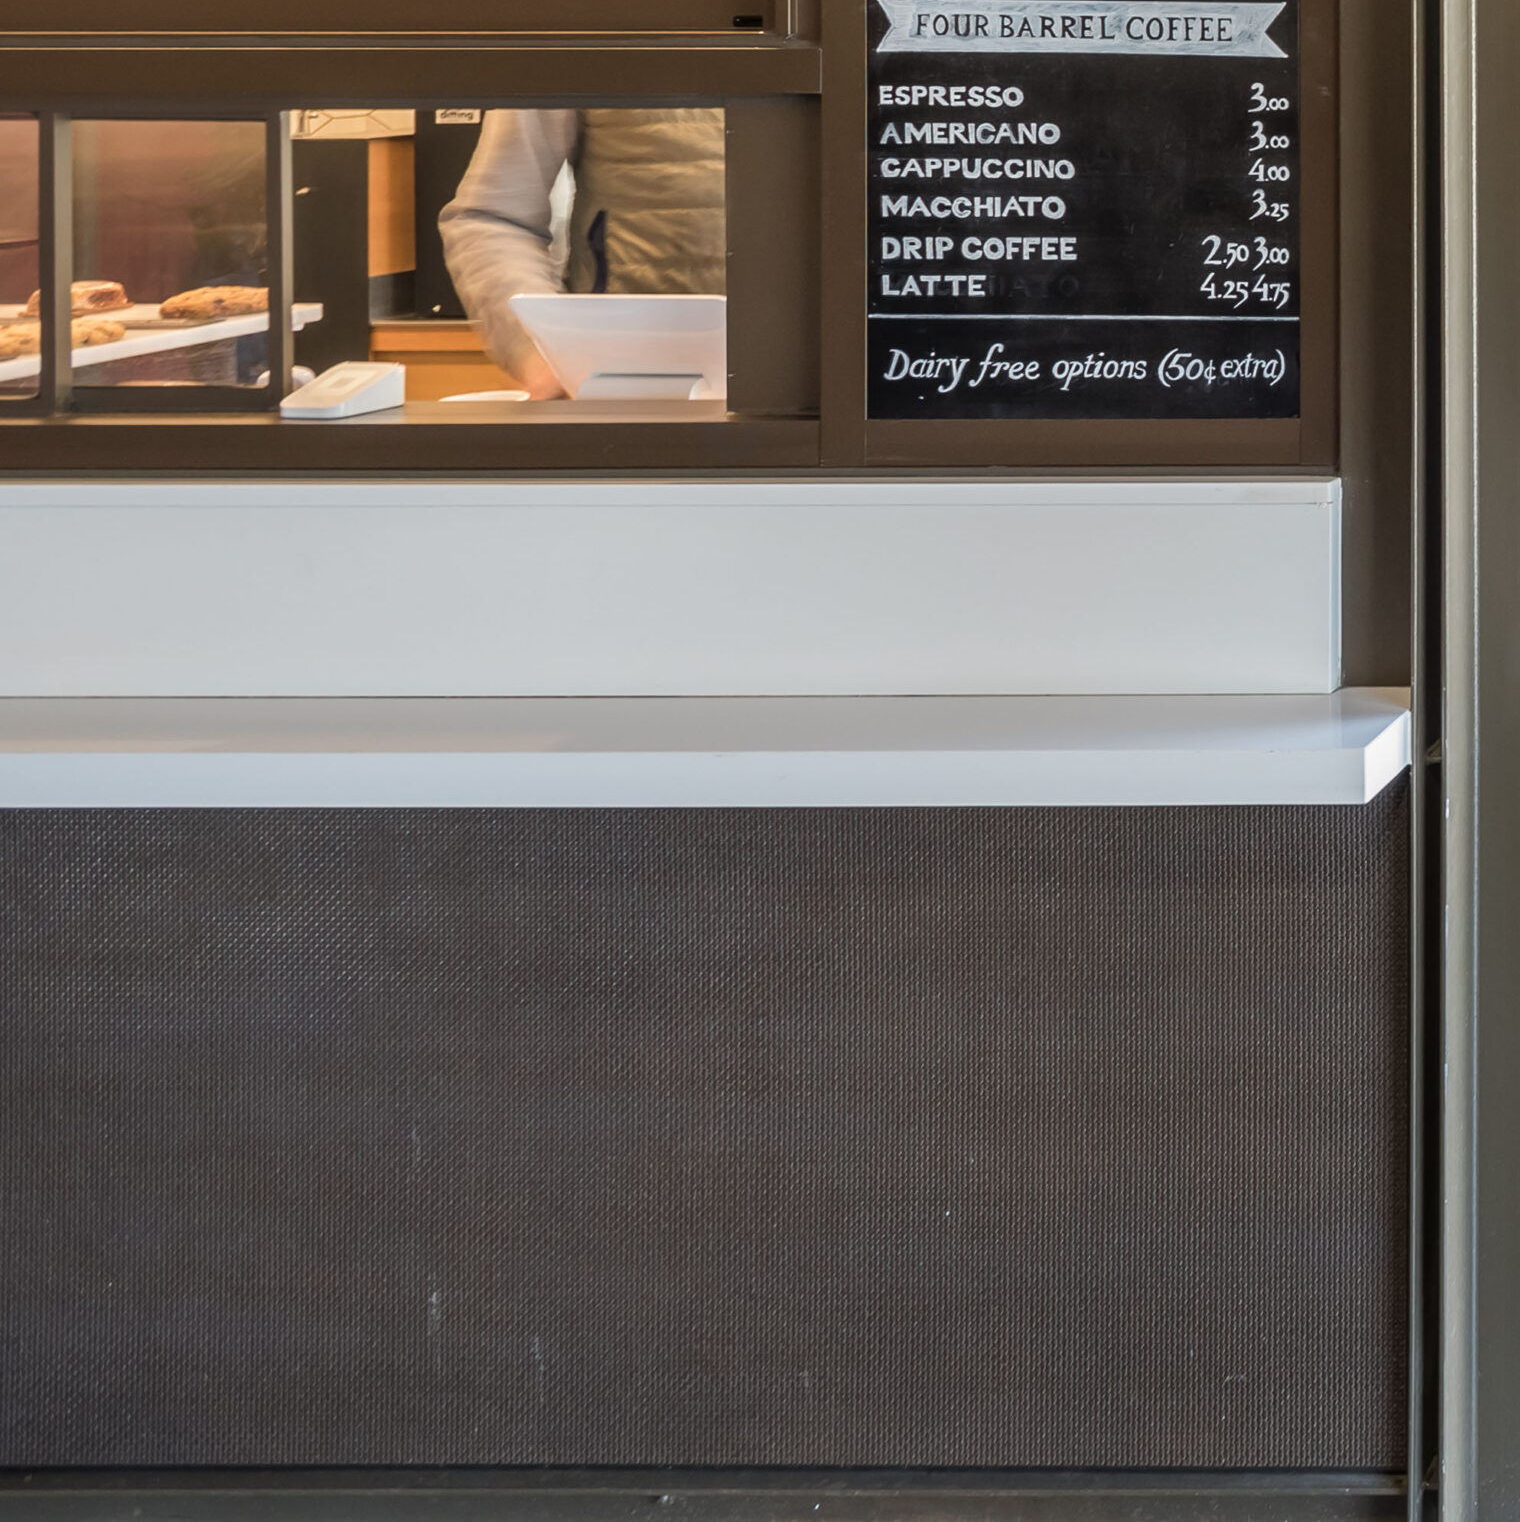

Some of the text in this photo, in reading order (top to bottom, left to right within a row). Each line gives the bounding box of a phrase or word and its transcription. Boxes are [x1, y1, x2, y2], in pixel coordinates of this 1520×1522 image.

[914, 13, 1235, 42] FOUR BARREL COFFEE
[879, 86, 1024, 107] ESPRESSO
[880, 123, 1060, 144] AMERICANO
[881, 158, 1075, 179] CAPPUCCINO
[882, 195, 1066, 219] MACCHIATO
[882, 237, 1077, 260] DRIP COFFEE
[882, 275, 986, 296] LATTE
[884, 343, 1285, 393] Dairy free options (50¢ extra)
